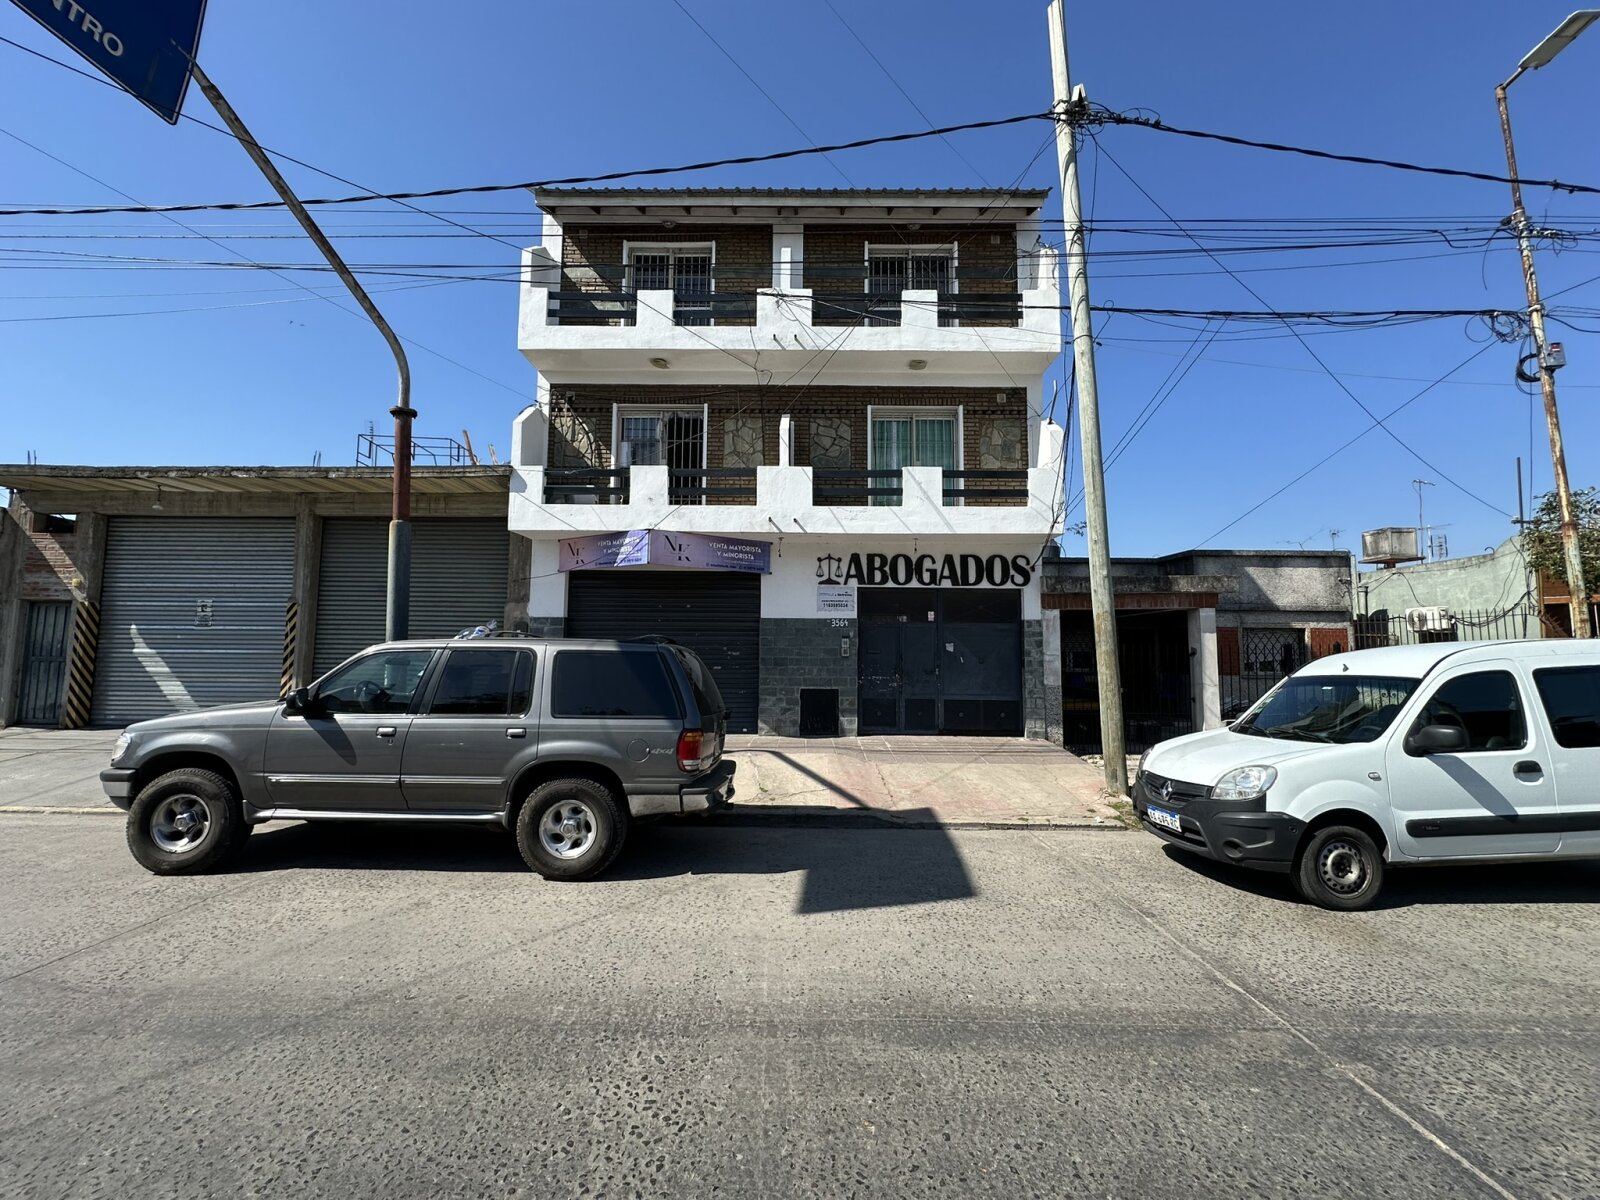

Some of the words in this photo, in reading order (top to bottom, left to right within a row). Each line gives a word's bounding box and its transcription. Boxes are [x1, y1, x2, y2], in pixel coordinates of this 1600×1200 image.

[708, 542, 728, 550] VENTA
[729, 544, 762, 553] MAYORISTA
[722, 552, 755, 560] MINORISTA
[843, 552, 1031, 587] ABOGADOS
[831, 618, 849, 627] 3564
